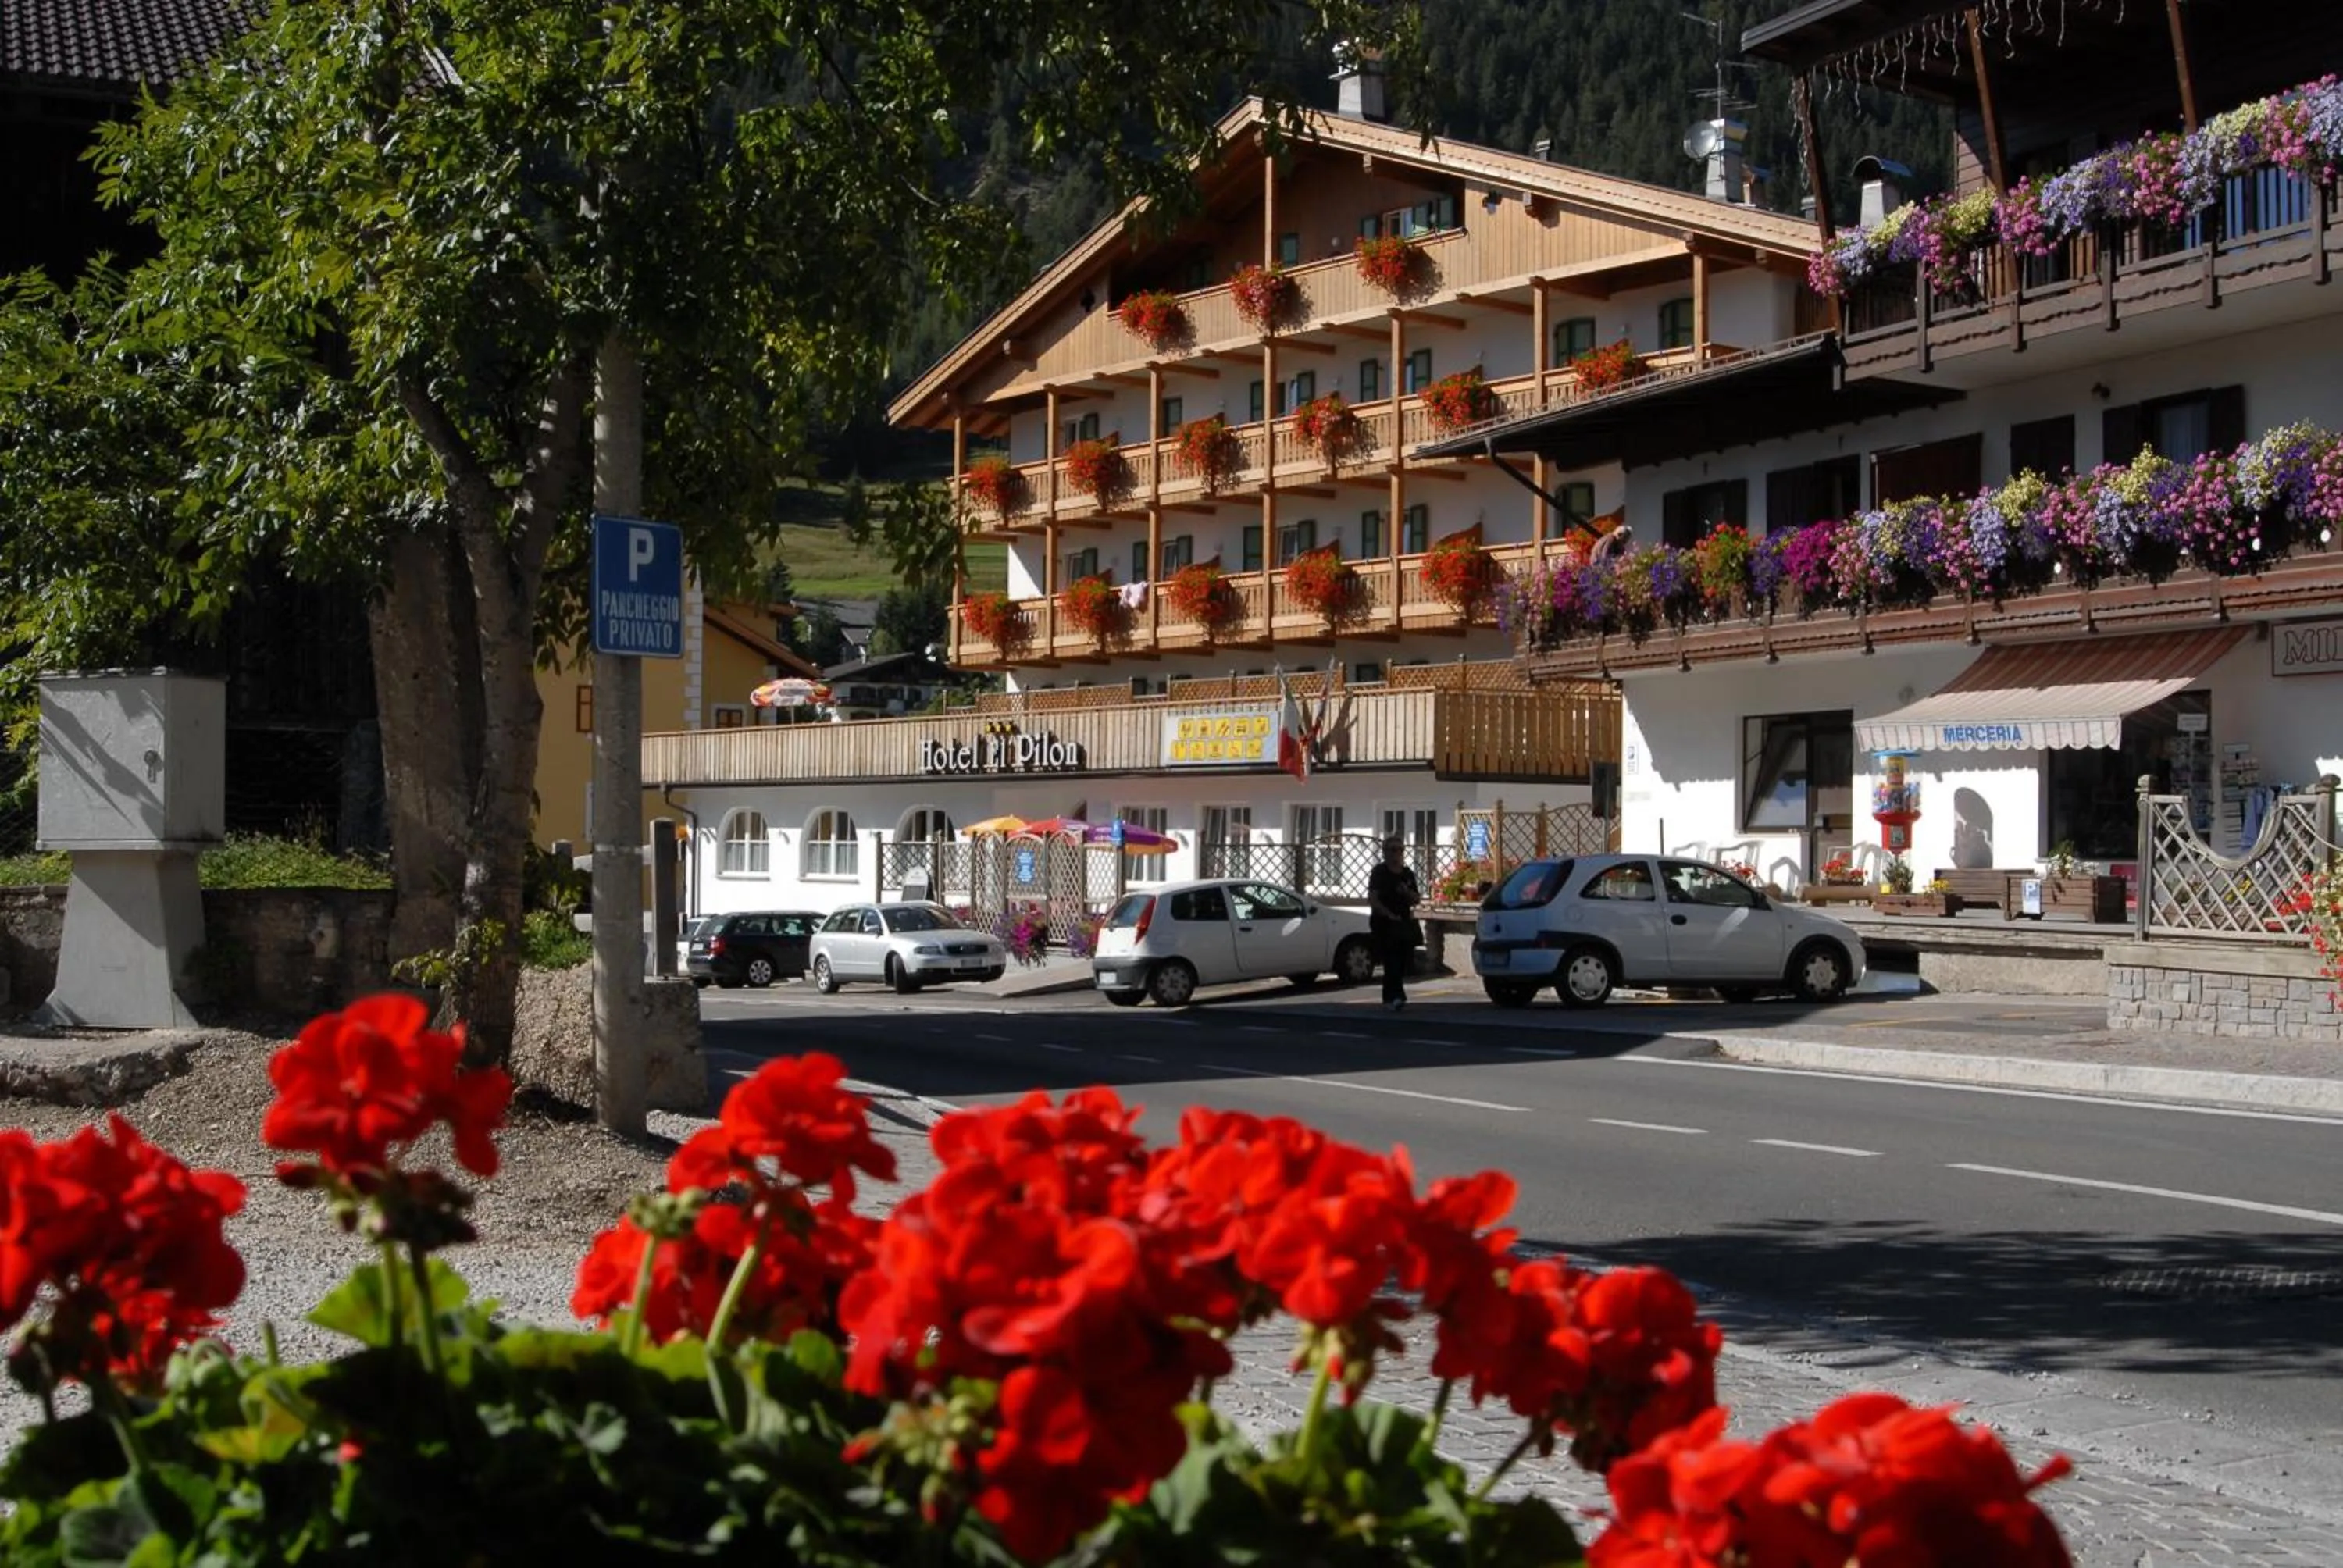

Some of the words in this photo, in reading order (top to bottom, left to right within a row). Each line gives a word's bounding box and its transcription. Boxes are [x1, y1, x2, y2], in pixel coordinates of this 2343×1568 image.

[629, 527, 654, 581] P
[601, 590, 679, 622] PARCHEGGIO
[609, 620, 672, 649] PRIVATO
[1942, 725, 2022, 743] MERCERIA
[920, 736, 979, 770] Hotel
[1011, 734, 1079, 766] Pilon
